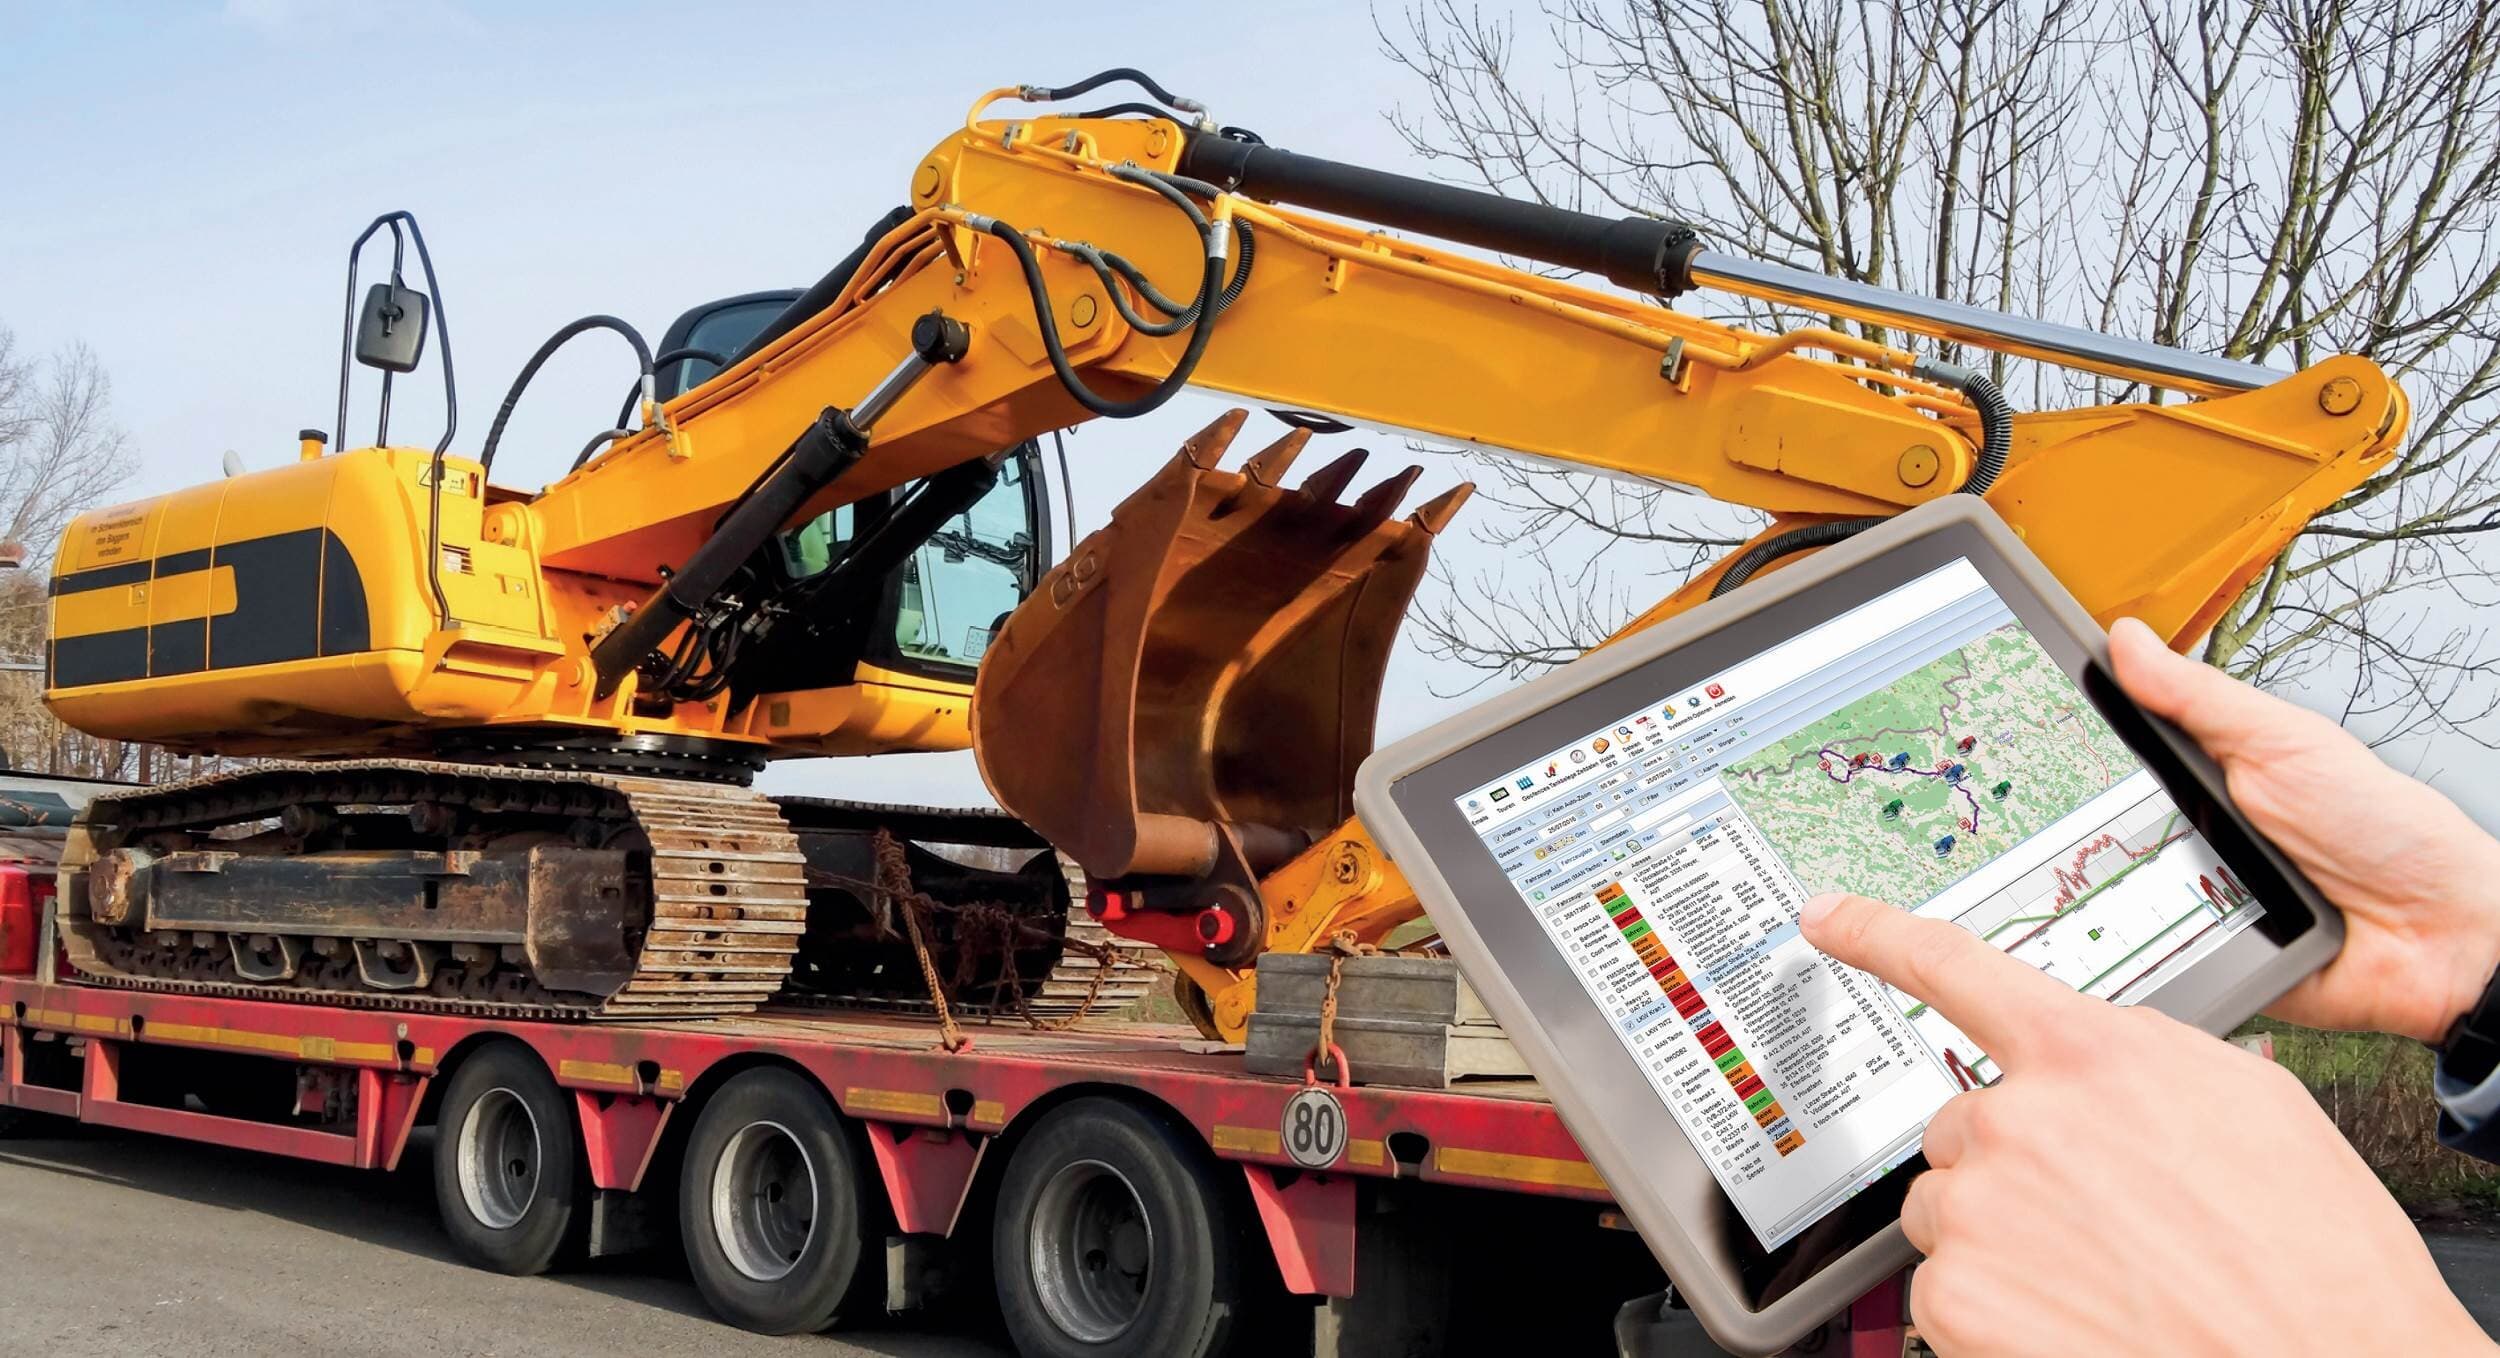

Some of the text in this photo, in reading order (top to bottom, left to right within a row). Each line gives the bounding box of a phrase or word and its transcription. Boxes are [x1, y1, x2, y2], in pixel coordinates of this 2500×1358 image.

[1521, 785, 1550, 801] Geofences
[1496, 802, 1515, 813] Touren
[1471, 814, 1489, 826] Emails
[1629, 854, 1651, 868] Adresse
[1590, 878, 1607, 889] Status
[1293, 1101, 1335, 1155] 80
